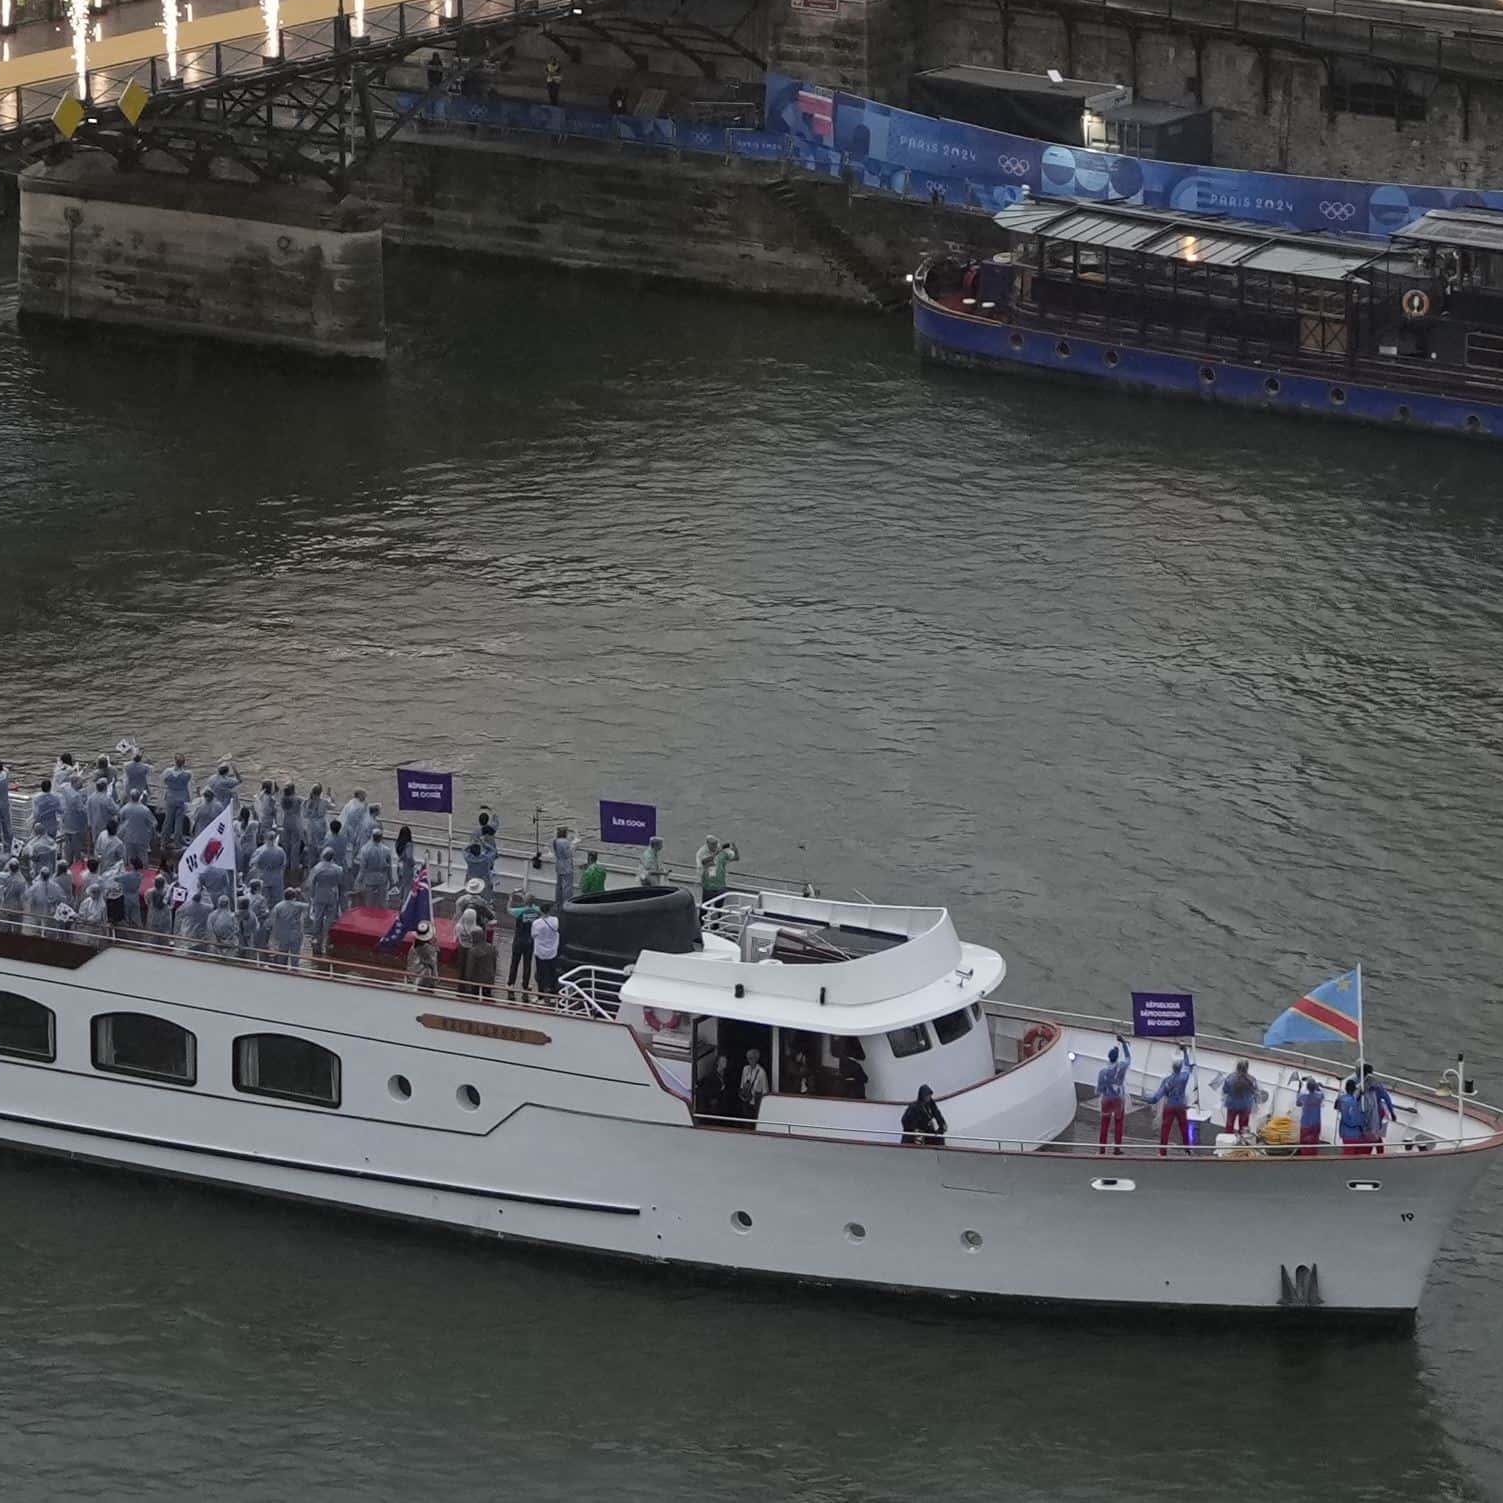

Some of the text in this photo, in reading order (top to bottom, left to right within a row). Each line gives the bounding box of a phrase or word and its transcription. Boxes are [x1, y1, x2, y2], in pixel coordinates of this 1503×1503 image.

[900, 135, 976, 161] PARIS 2024
[1210, 193, 1294, 212] PARIS 2024
[407, 781, 444, 791] RÉPUB
